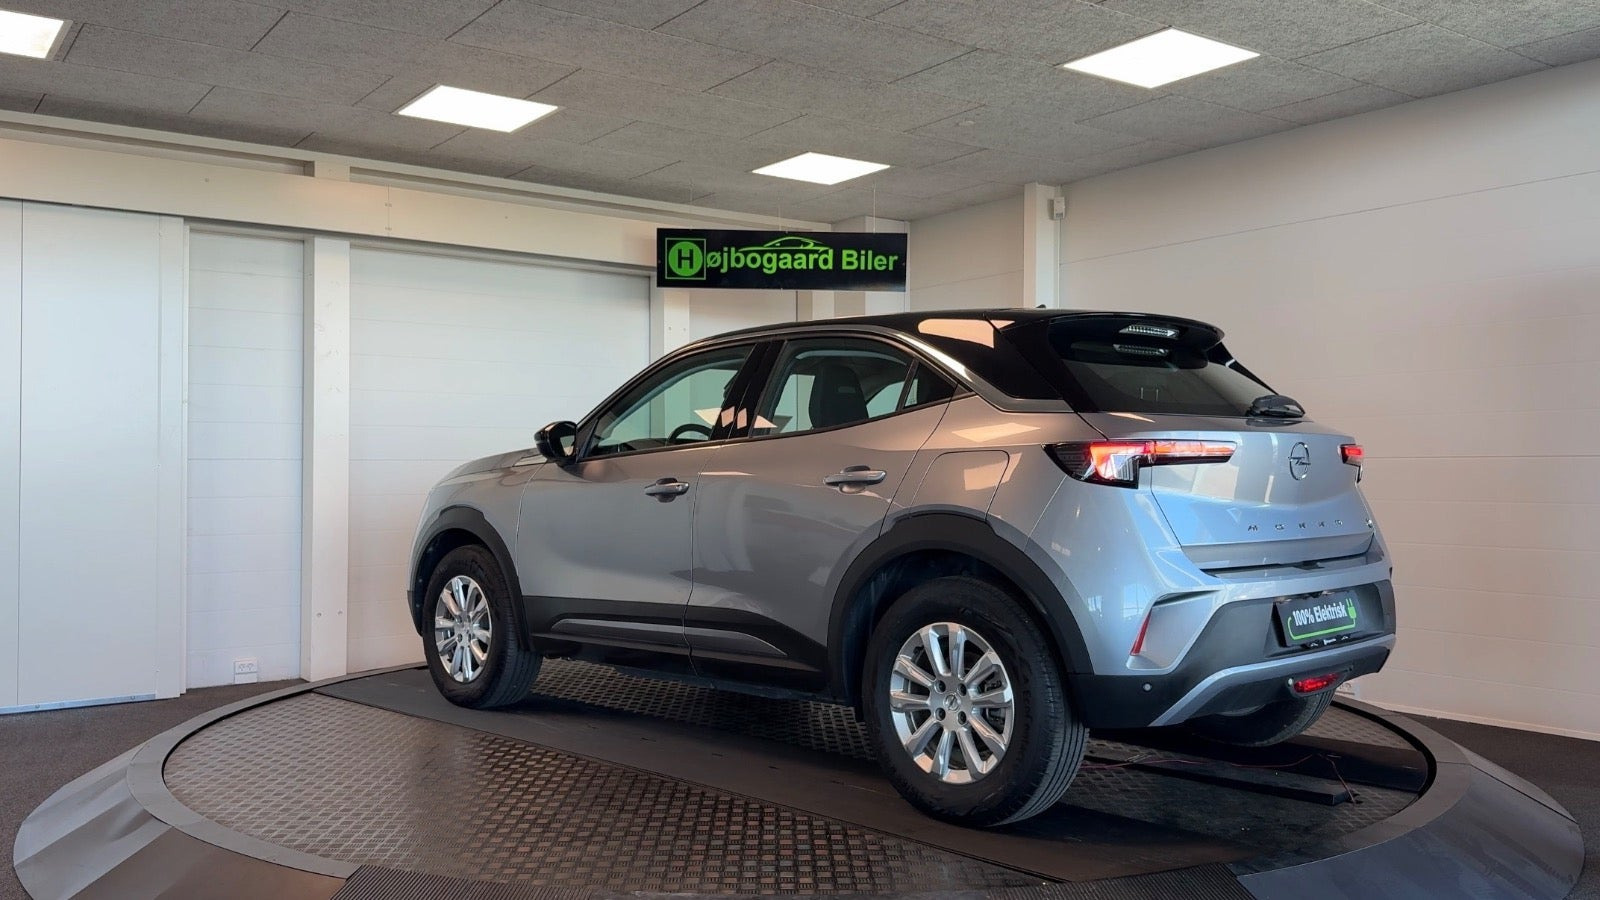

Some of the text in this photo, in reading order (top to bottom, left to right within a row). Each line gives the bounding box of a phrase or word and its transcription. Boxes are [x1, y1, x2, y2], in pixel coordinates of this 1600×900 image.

[841, 249, 898, 271] Biler
[1293, 602, 1348, 627] 100% Elektrisk
